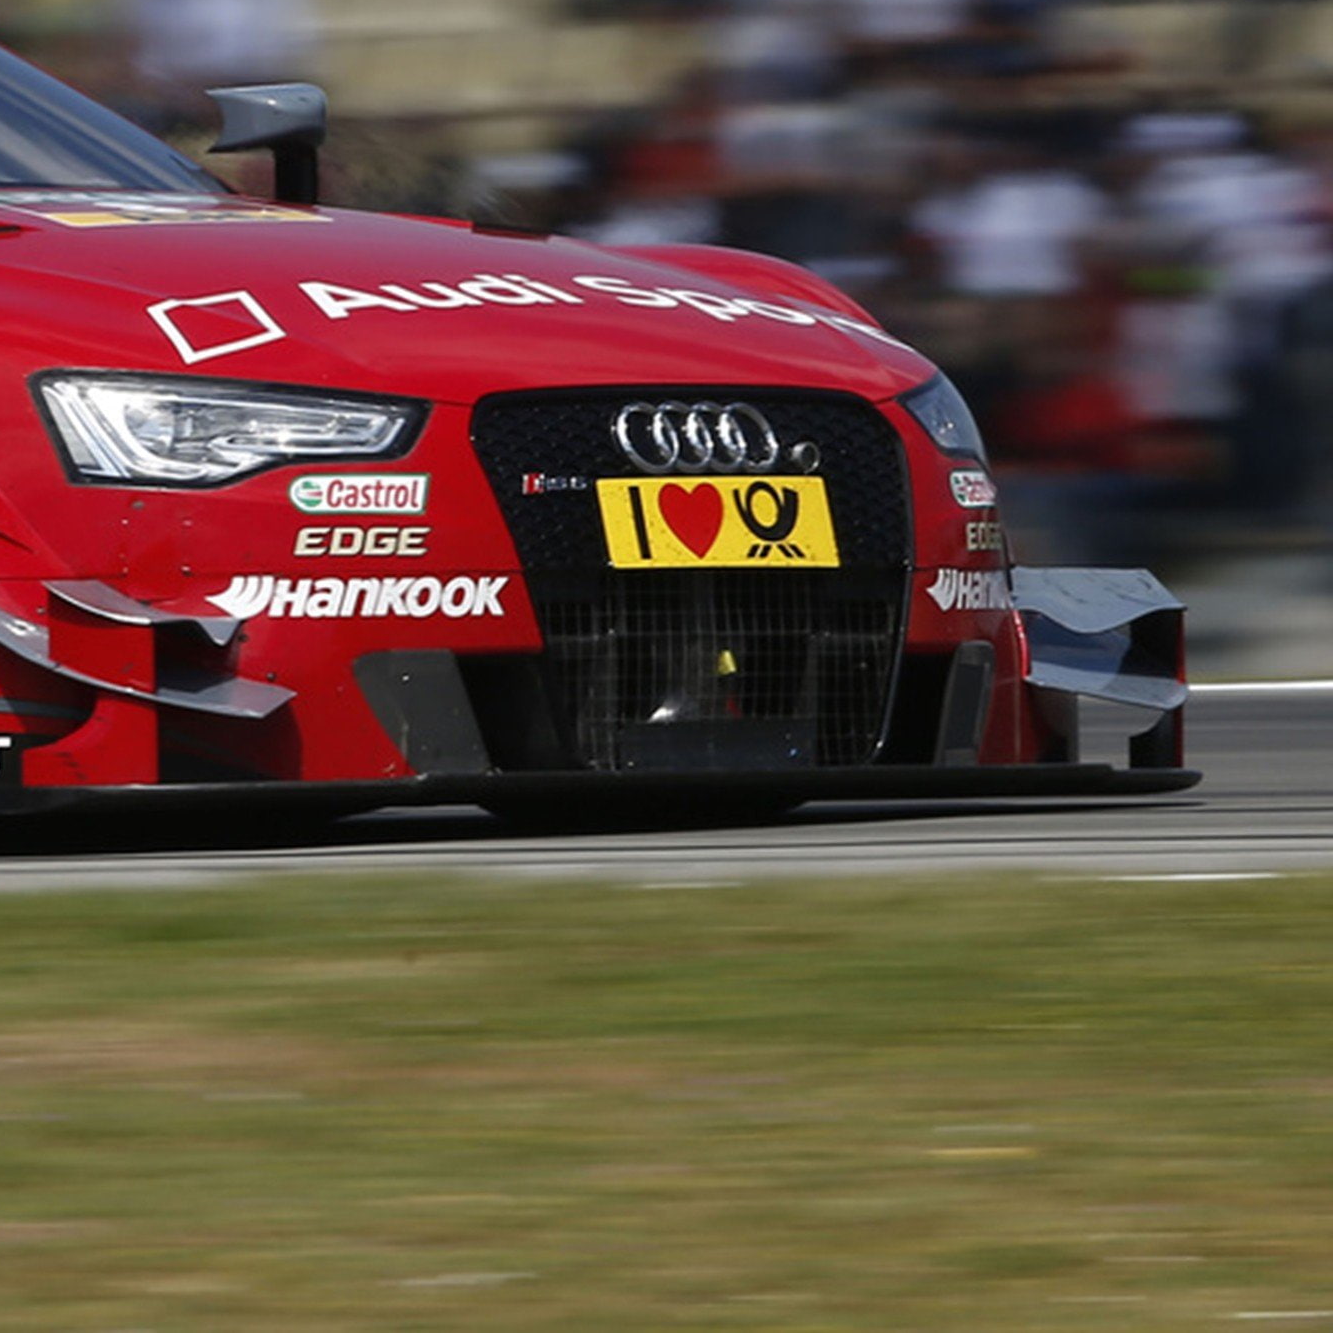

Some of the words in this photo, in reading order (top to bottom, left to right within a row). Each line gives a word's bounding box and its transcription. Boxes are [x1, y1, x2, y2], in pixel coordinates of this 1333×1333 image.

[298, 273, 583, 320] Audi
[325, 479, 420, 509] Castrol
[293, 527, 432, 556] EDGE
[628, 484, 653, 561] I
